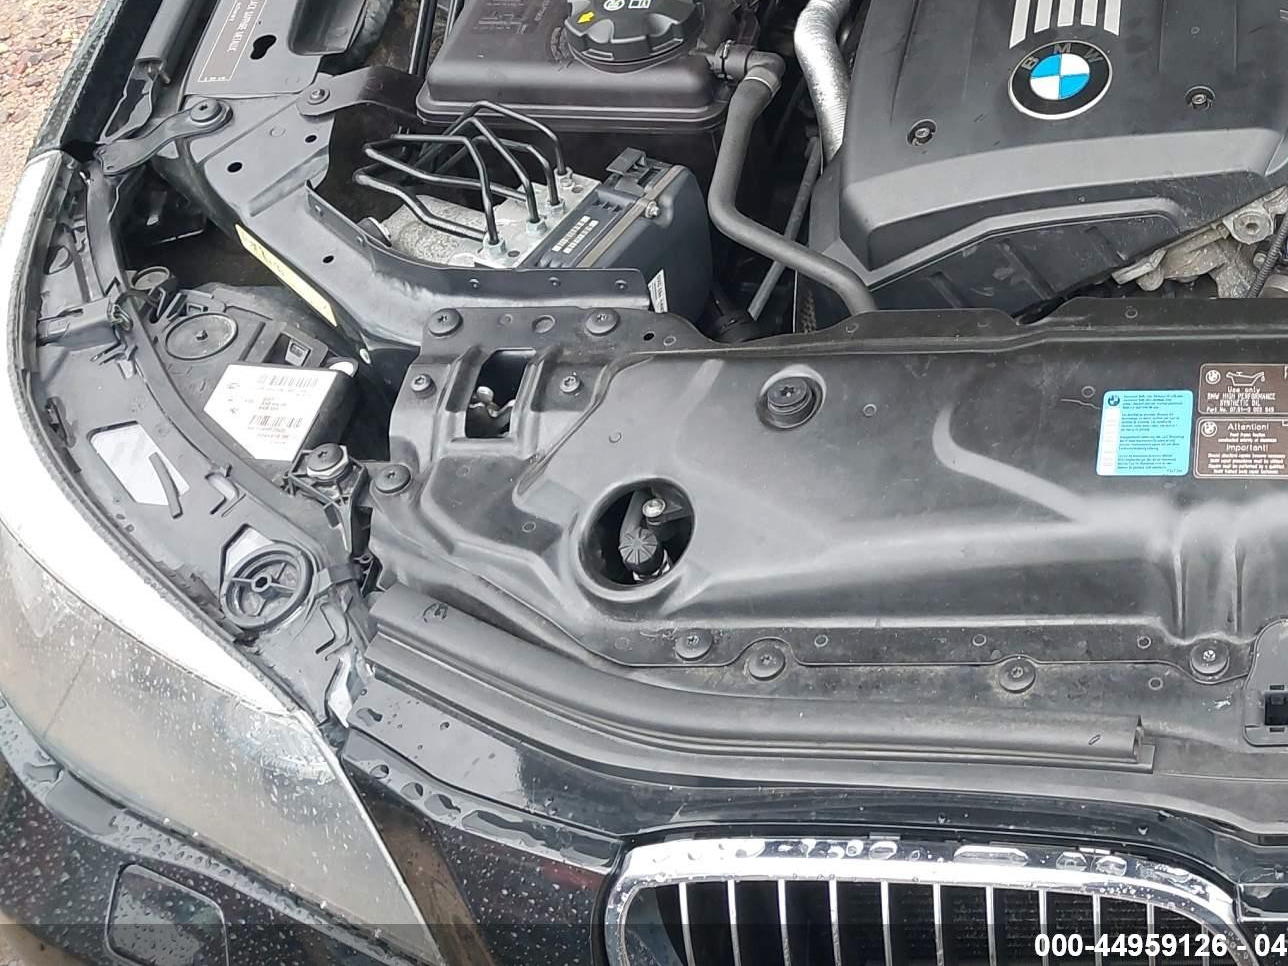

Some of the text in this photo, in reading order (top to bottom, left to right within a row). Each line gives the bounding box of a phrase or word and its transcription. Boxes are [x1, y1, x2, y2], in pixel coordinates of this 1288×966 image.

[1227, 385, 1261, 394] Use only
[1237, 392, 1276, 401] PERFORMANCE
[1219, 399, 1261, 407] SYNTHETIC OIL
[1227, 423, 1269, 431] Attention!
[1226, 444, 1269, 452] Important!
